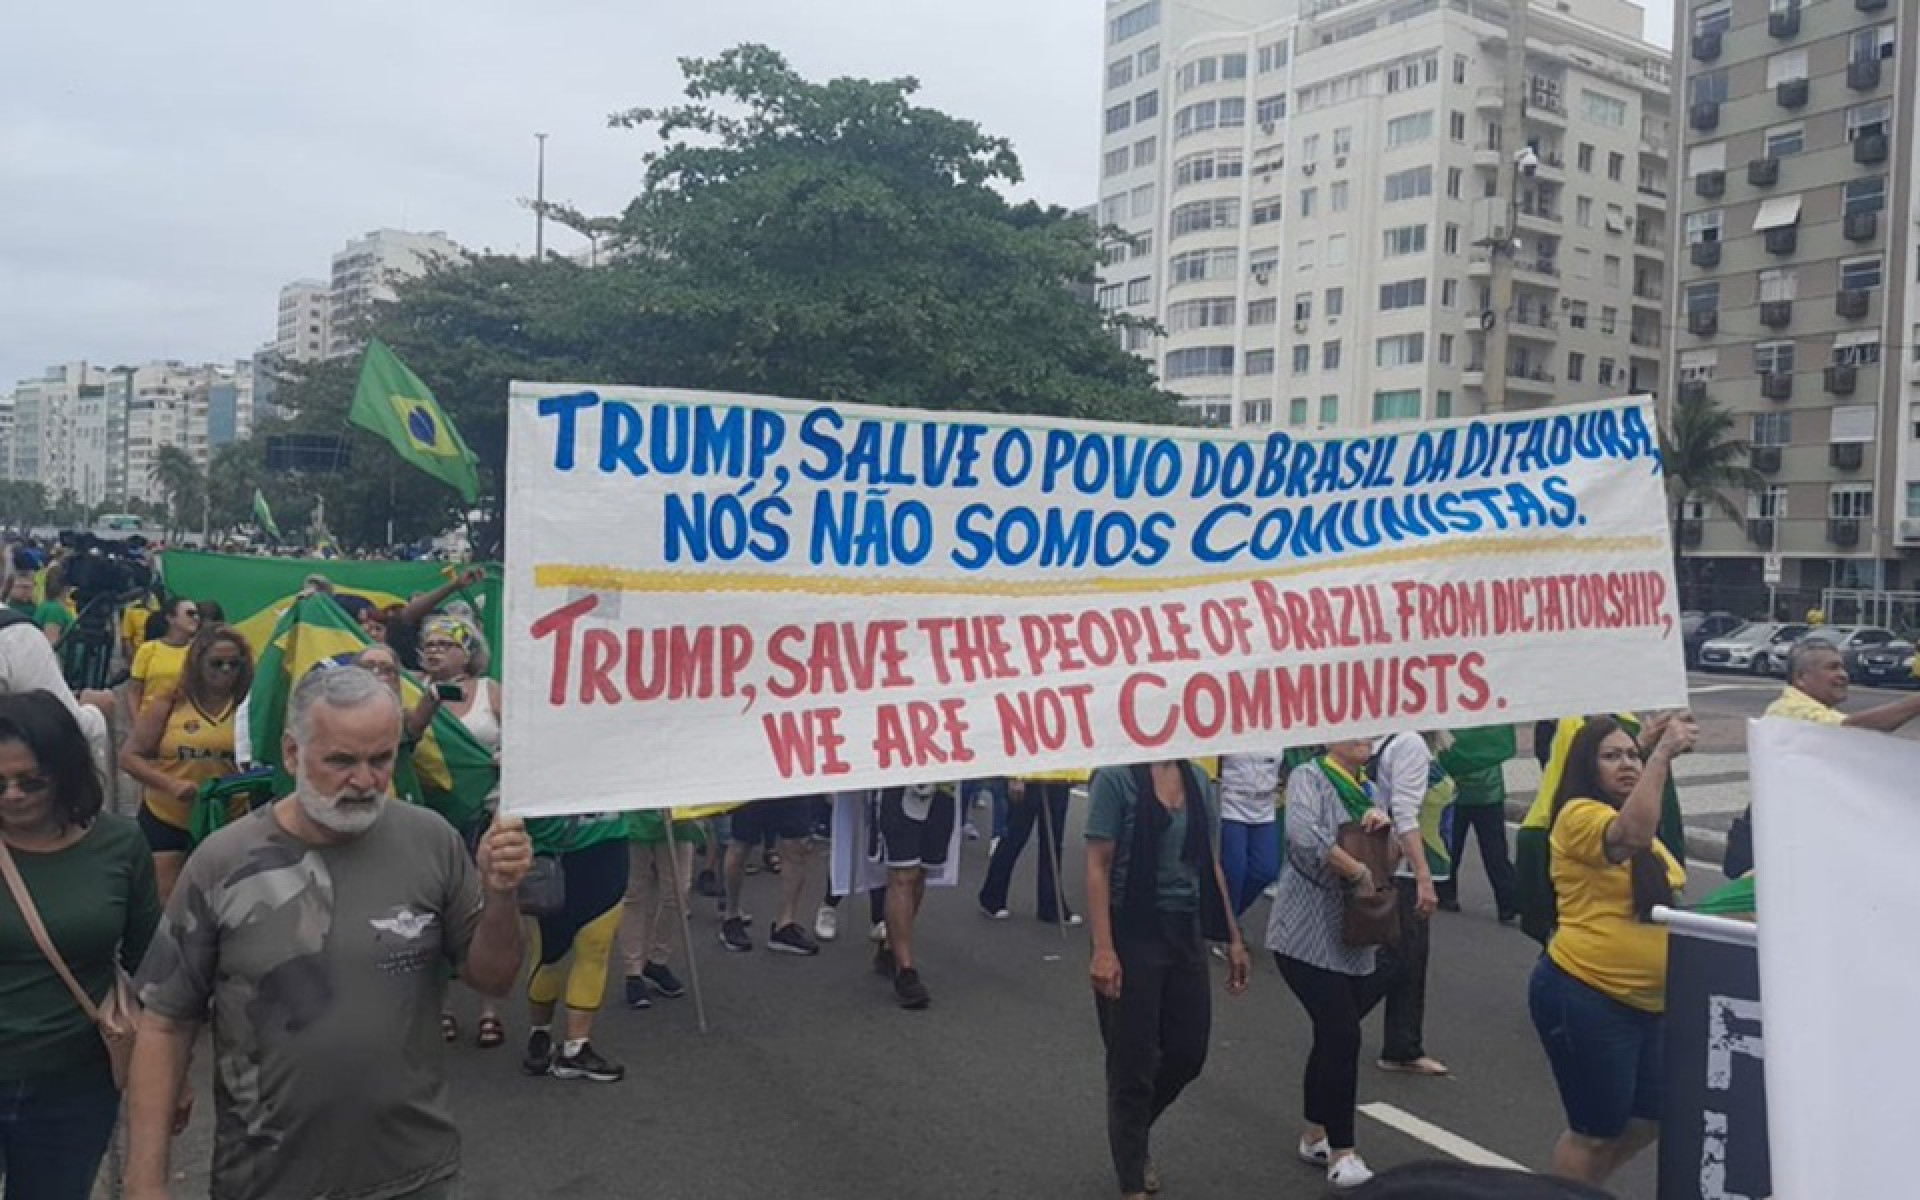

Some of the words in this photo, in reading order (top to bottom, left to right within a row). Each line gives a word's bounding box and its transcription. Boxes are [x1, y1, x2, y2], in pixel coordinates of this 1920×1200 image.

[537, 391, 791, 496] TRUMP,
[799, 408, 986, 489] SALVE
[994, 428, 1033, 488] O
[1042, 430, 1183, 500] POVO
[1191, 441, 1254, 499] DO
[1256, 432, 1398, 496] BRASIL
[1403, 428, 1458, 487] DA
[664, 480, 793, 563] NÓS
[810, 487, 933, 567] NÃO
[951, 503, 1176, 570] SOMOS
[1191, 475, 1587, 564] COMUNISTAS.
[530, 593, 757, 713] TRUMP,
[767, 620, 915, 699] SAVE
[917, 615, 1018, 684] THE
[1022, 603, 1200, 676] PEOPLE
[1201, 597, 1252, 656] OF
[1251, 580, 1390, 653] BRAZIL
[1392, 580, 1489, 642] FROM
[1491, 570, 1673, 640] DICTATORSHIP,
[762, 707, 851, 779] WE
[872, 699, 975, 769] ARE
[996, 685, 1093, 757] NOT
[1118, 651, 1508, 747] COMMUNISTS.
